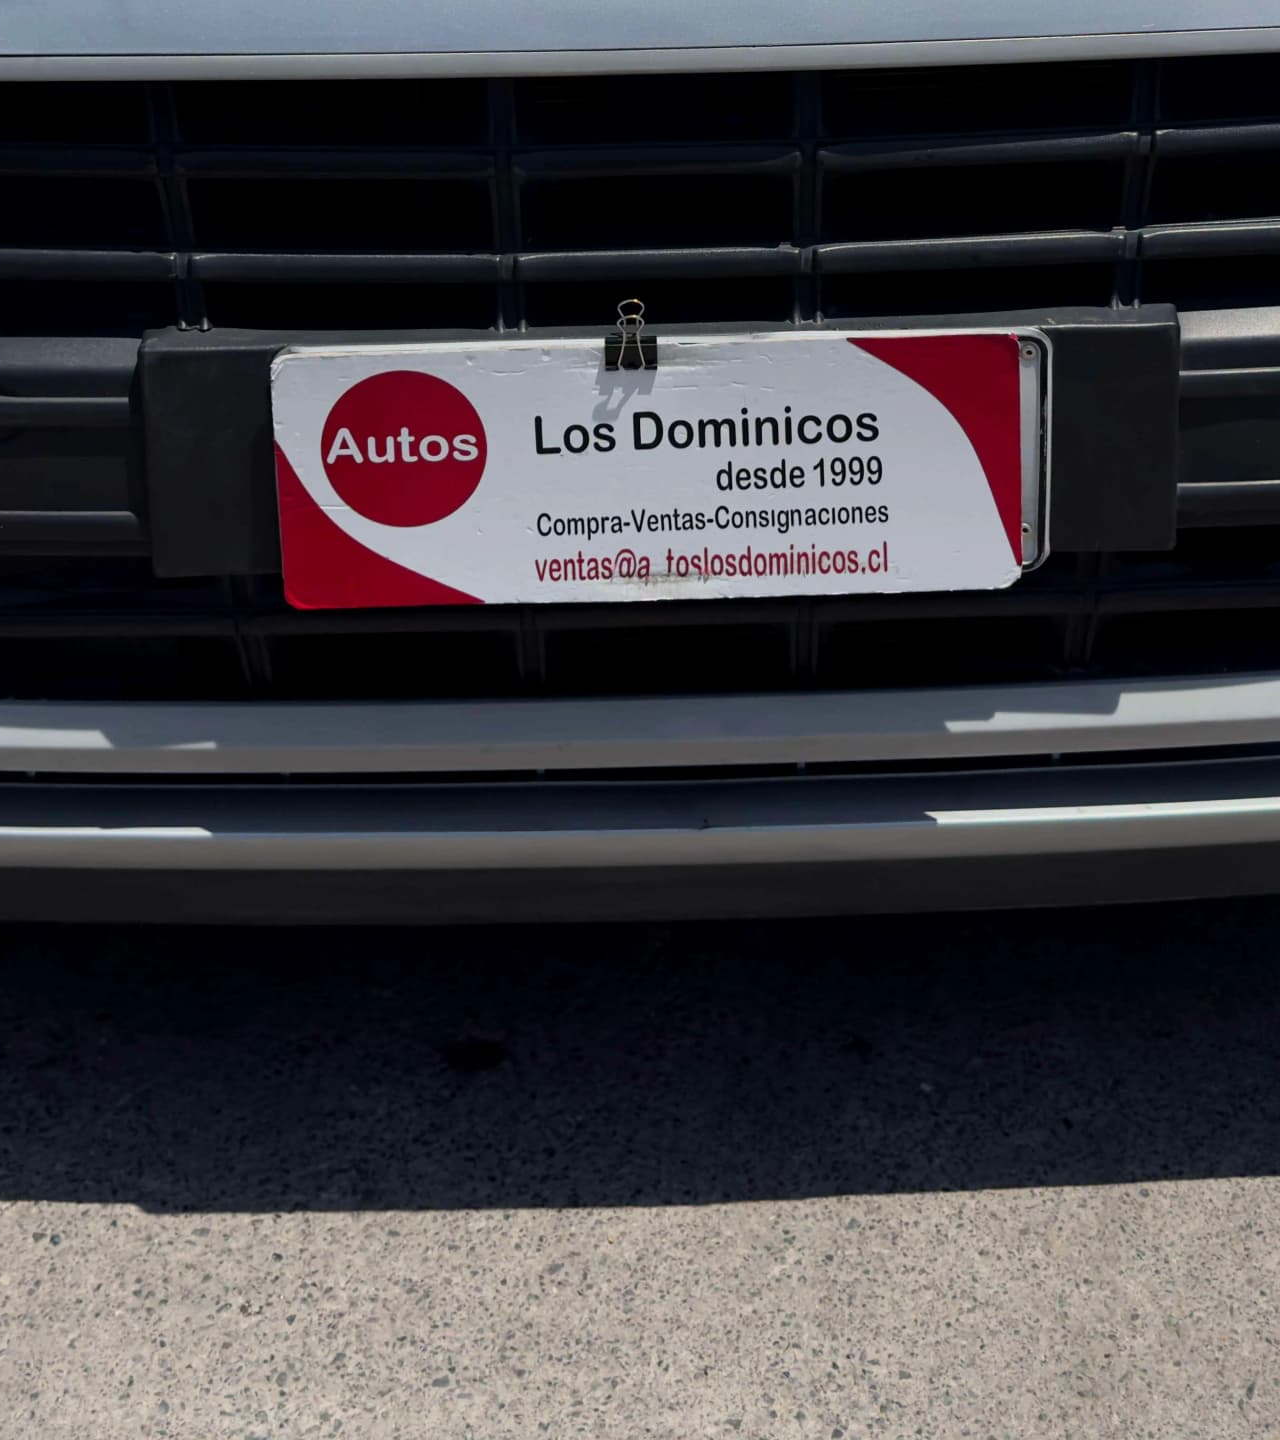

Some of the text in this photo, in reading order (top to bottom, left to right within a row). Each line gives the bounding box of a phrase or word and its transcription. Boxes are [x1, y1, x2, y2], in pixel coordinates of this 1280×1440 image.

[326, 426, 480, 465] Autos
[534, 405, 881, 455] Los Dominicos
[716, 455, 884, 492] desde 1999
[535, 504, 889, 541] Compra-Ventas-Consignaciones
[535, 541, 889, 582] ventas@atoslosdominicos.cl
